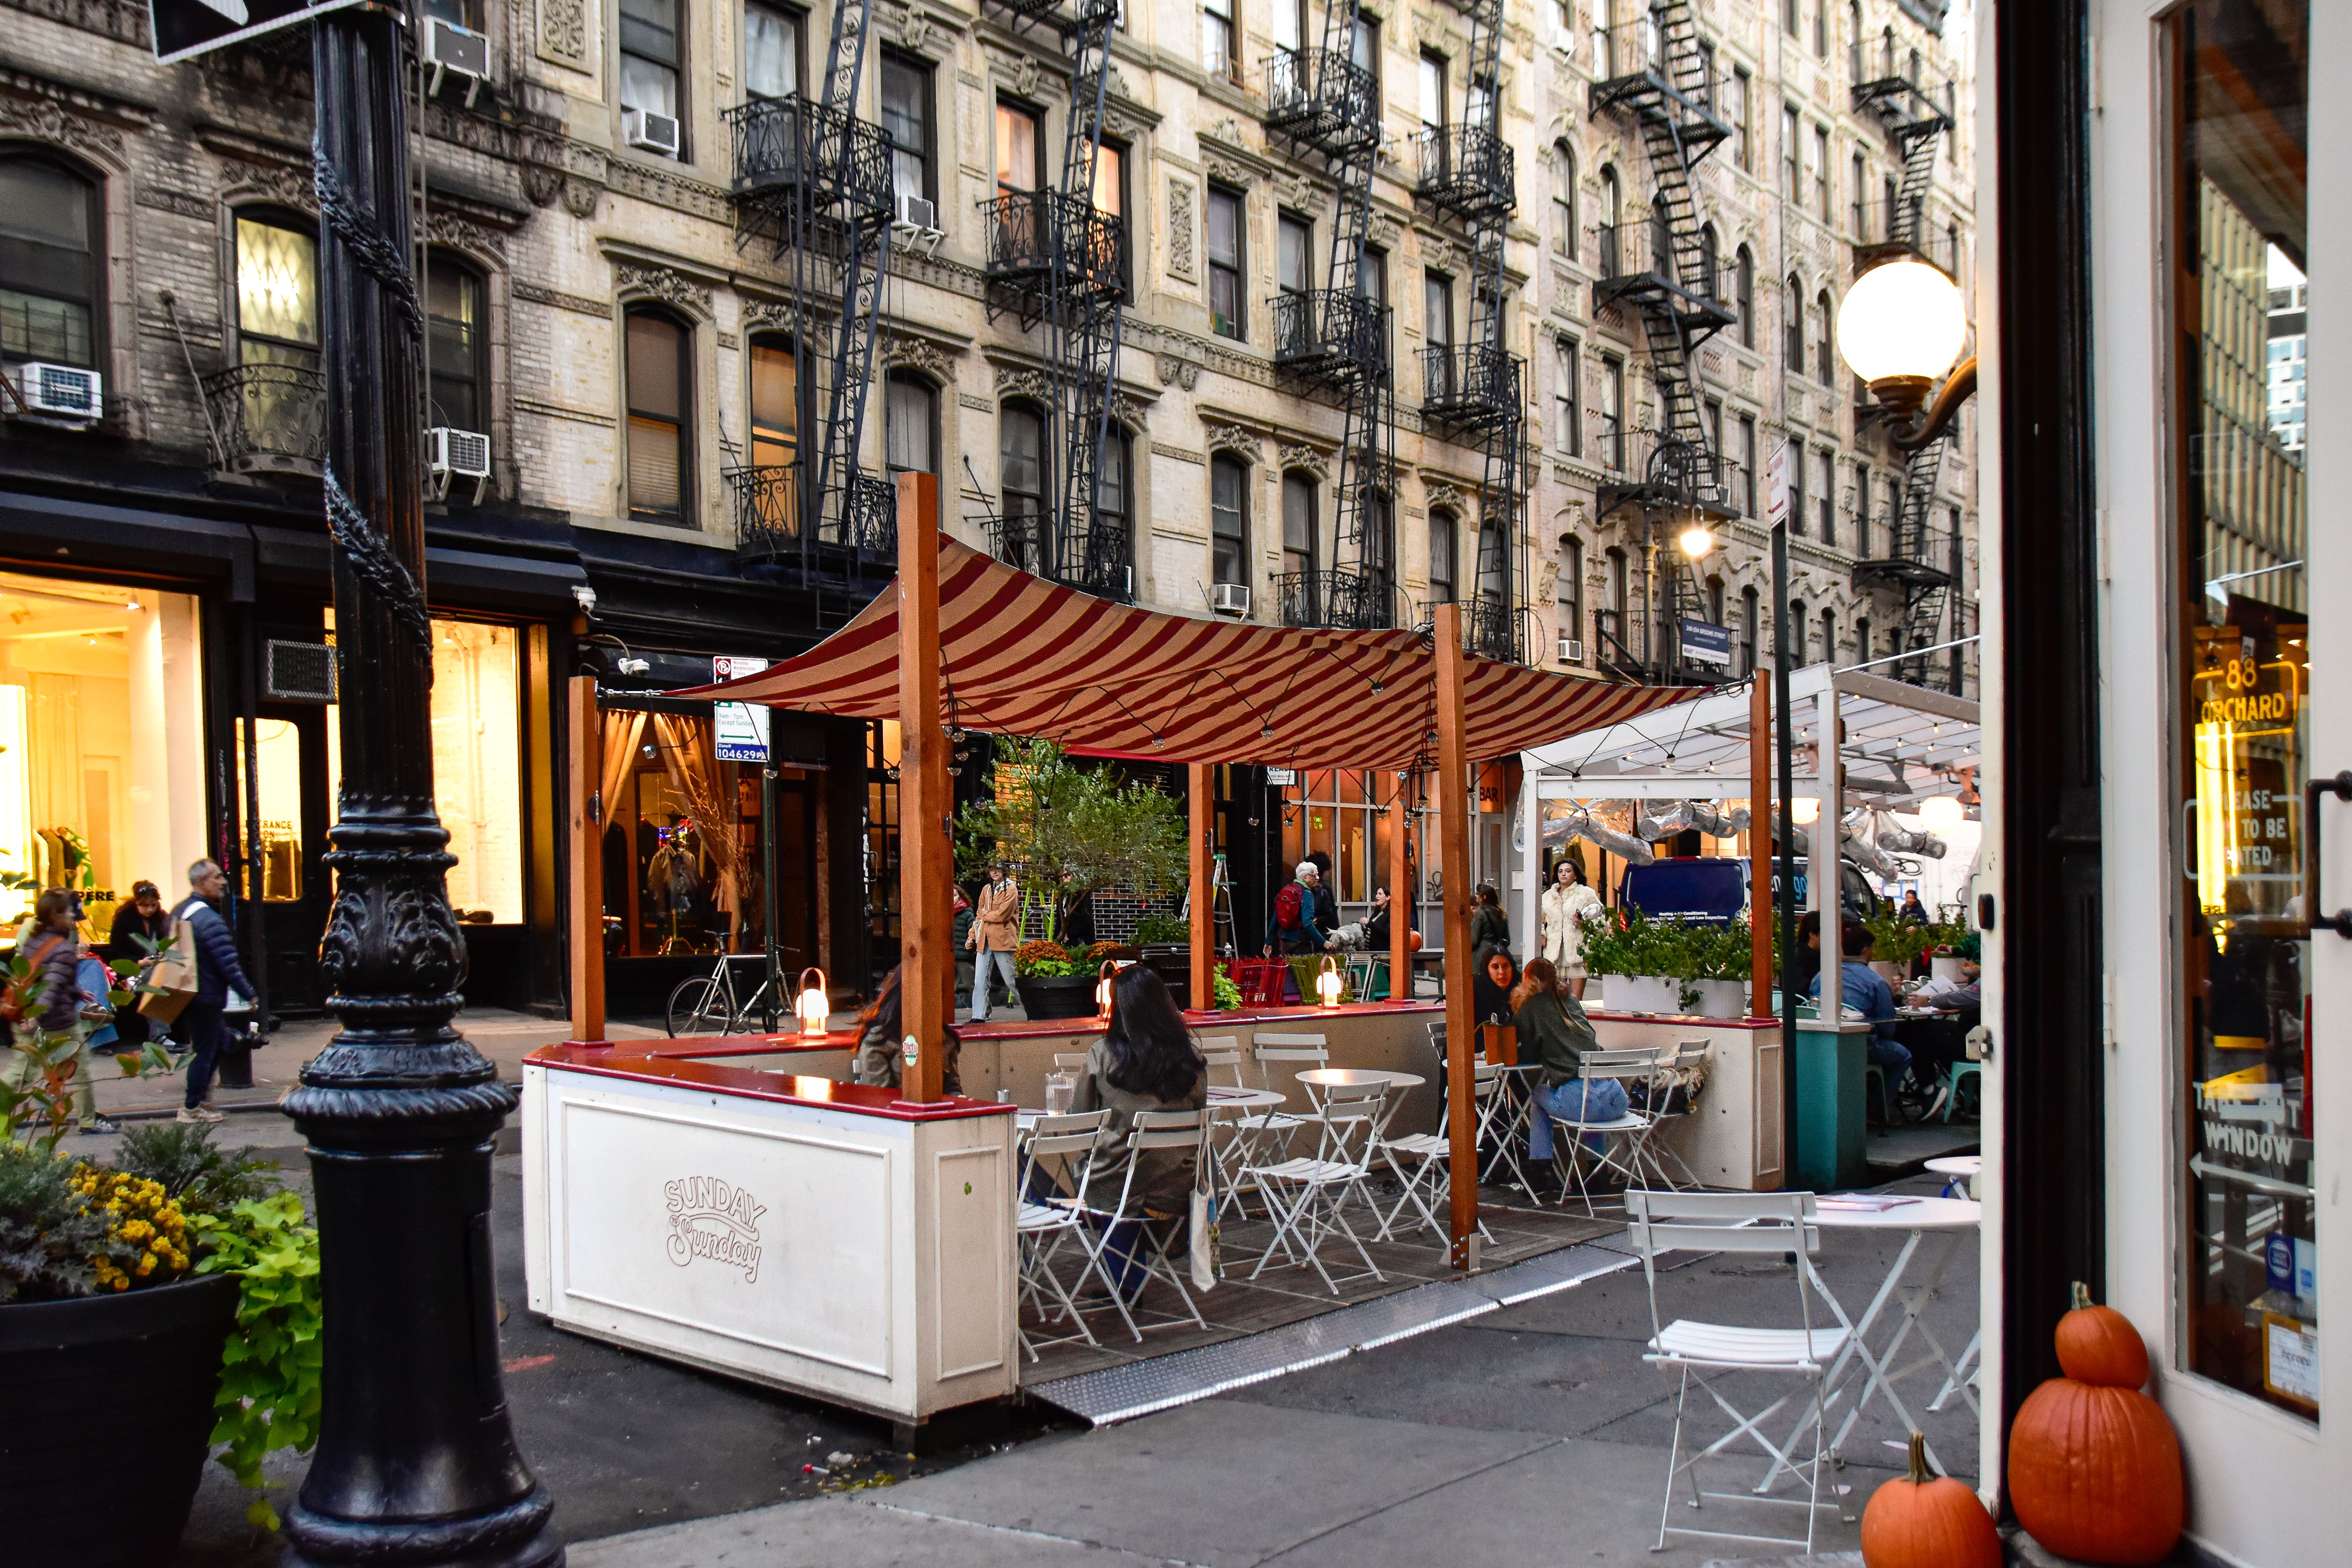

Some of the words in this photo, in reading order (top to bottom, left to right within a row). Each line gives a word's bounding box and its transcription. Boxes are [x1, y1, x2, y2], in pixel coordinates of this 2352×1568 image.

[2226, 658, 2257, 689] 88
[2201, 693, 2285, 724] ORCHARD
[1480, 787, 1498, 802] BAR
[2241, 818, 2260, 838] TO
[2266, 818, 2286, 838] BE
[2204, 1121, 2292, 1165] WINDOW
[665, 1176, 767, 1228] SUNDAY
[667, 1213, 761, 1283] Sunday
